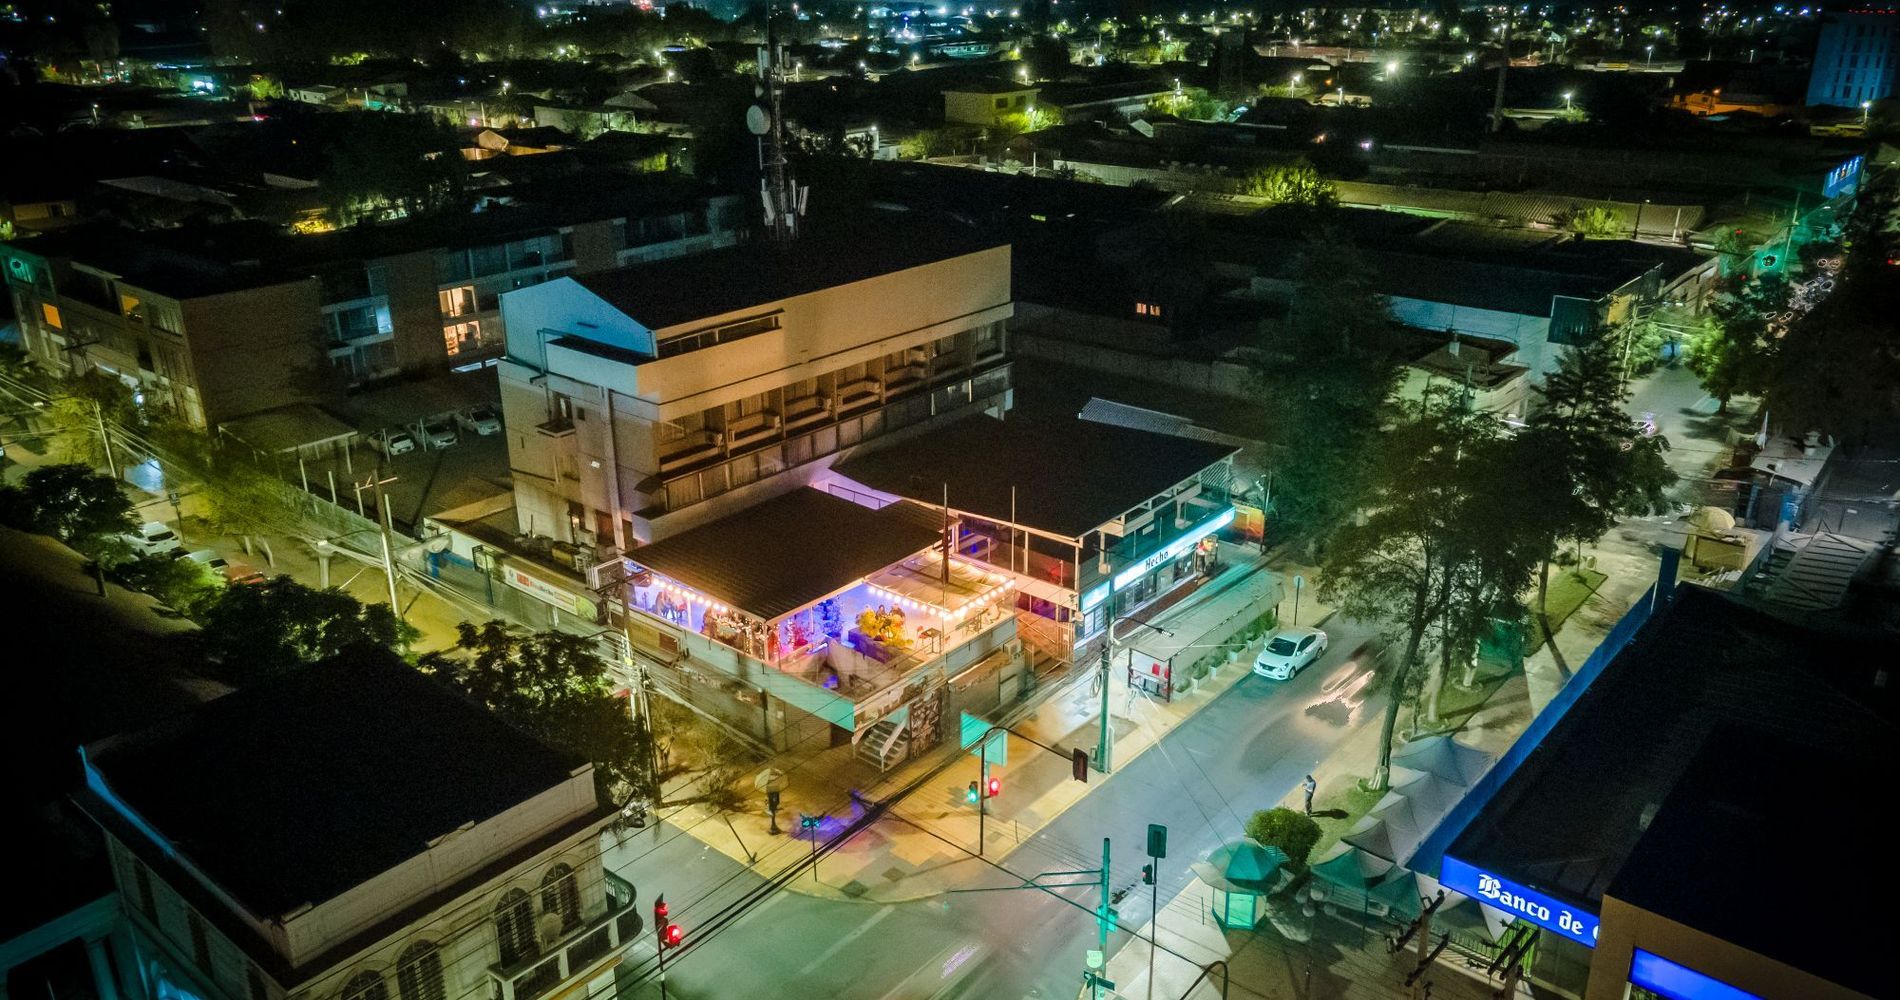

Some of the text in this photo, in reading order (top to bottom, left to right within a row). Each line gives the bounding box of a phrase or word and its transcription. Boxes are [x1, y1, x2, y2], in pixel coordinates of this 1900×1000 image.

[1145, 551, 1169, 571] Hecho
[1477, 873, 1550, 921] Banco
[1558, 910, 1584, 935] de
